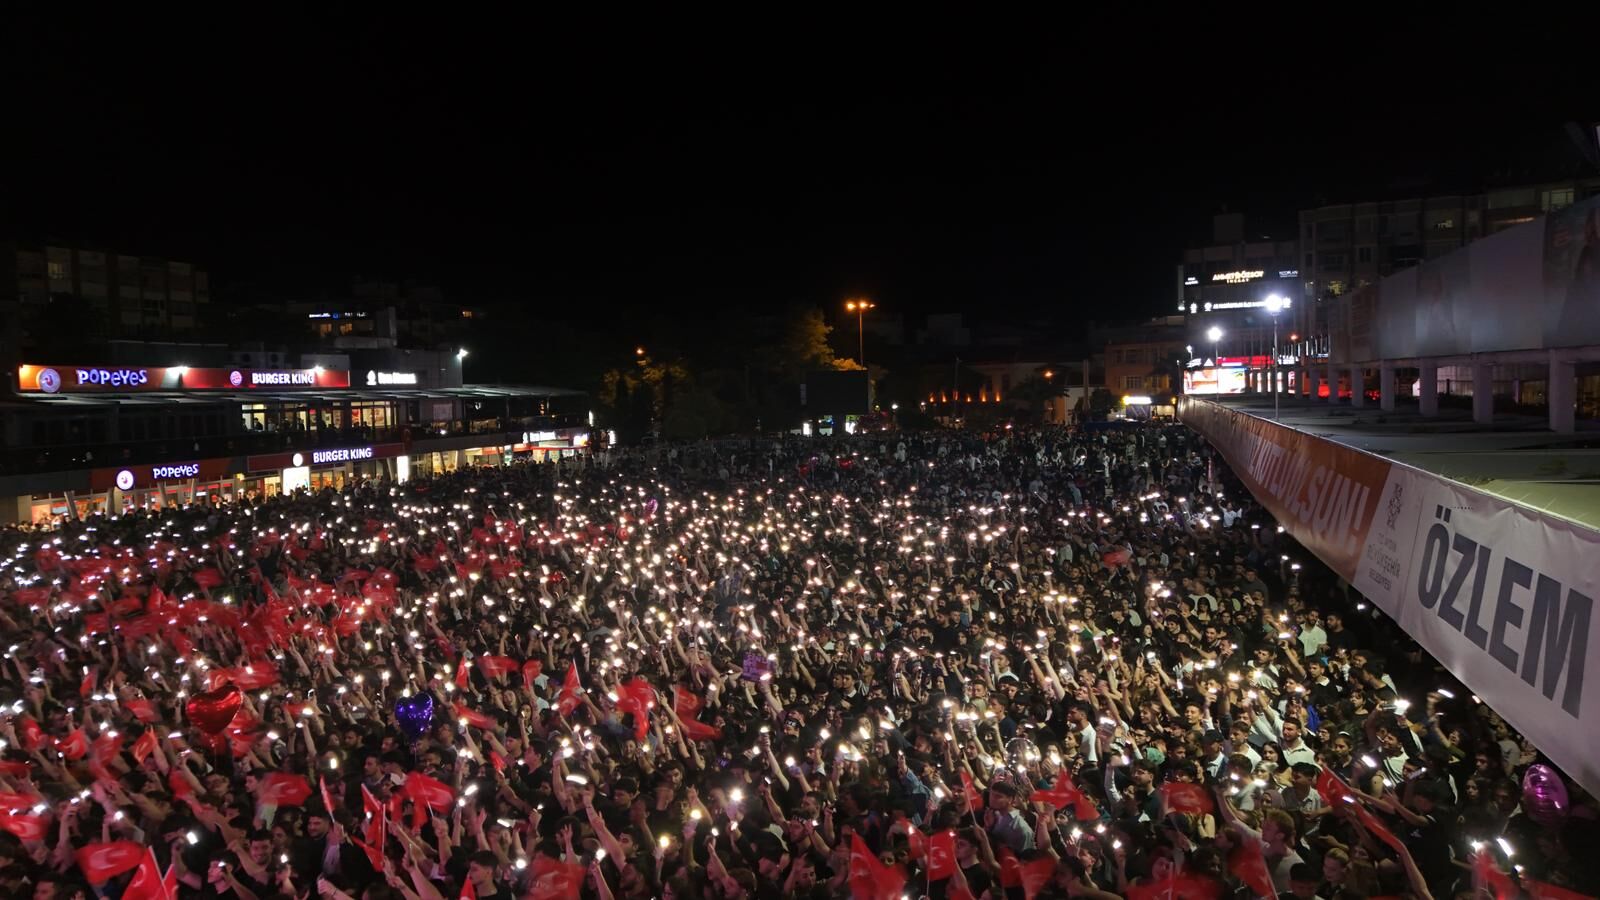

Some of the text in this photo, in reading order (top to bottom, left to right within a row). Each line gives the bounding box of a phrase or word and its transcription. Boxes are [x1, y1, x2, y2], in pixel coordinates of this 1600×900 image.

[252, 373, 315, 384] BURGER KING
[313, 448, 372, 463] BURGER KING
[1418, 504, 1594, 720] ÖZLEM
